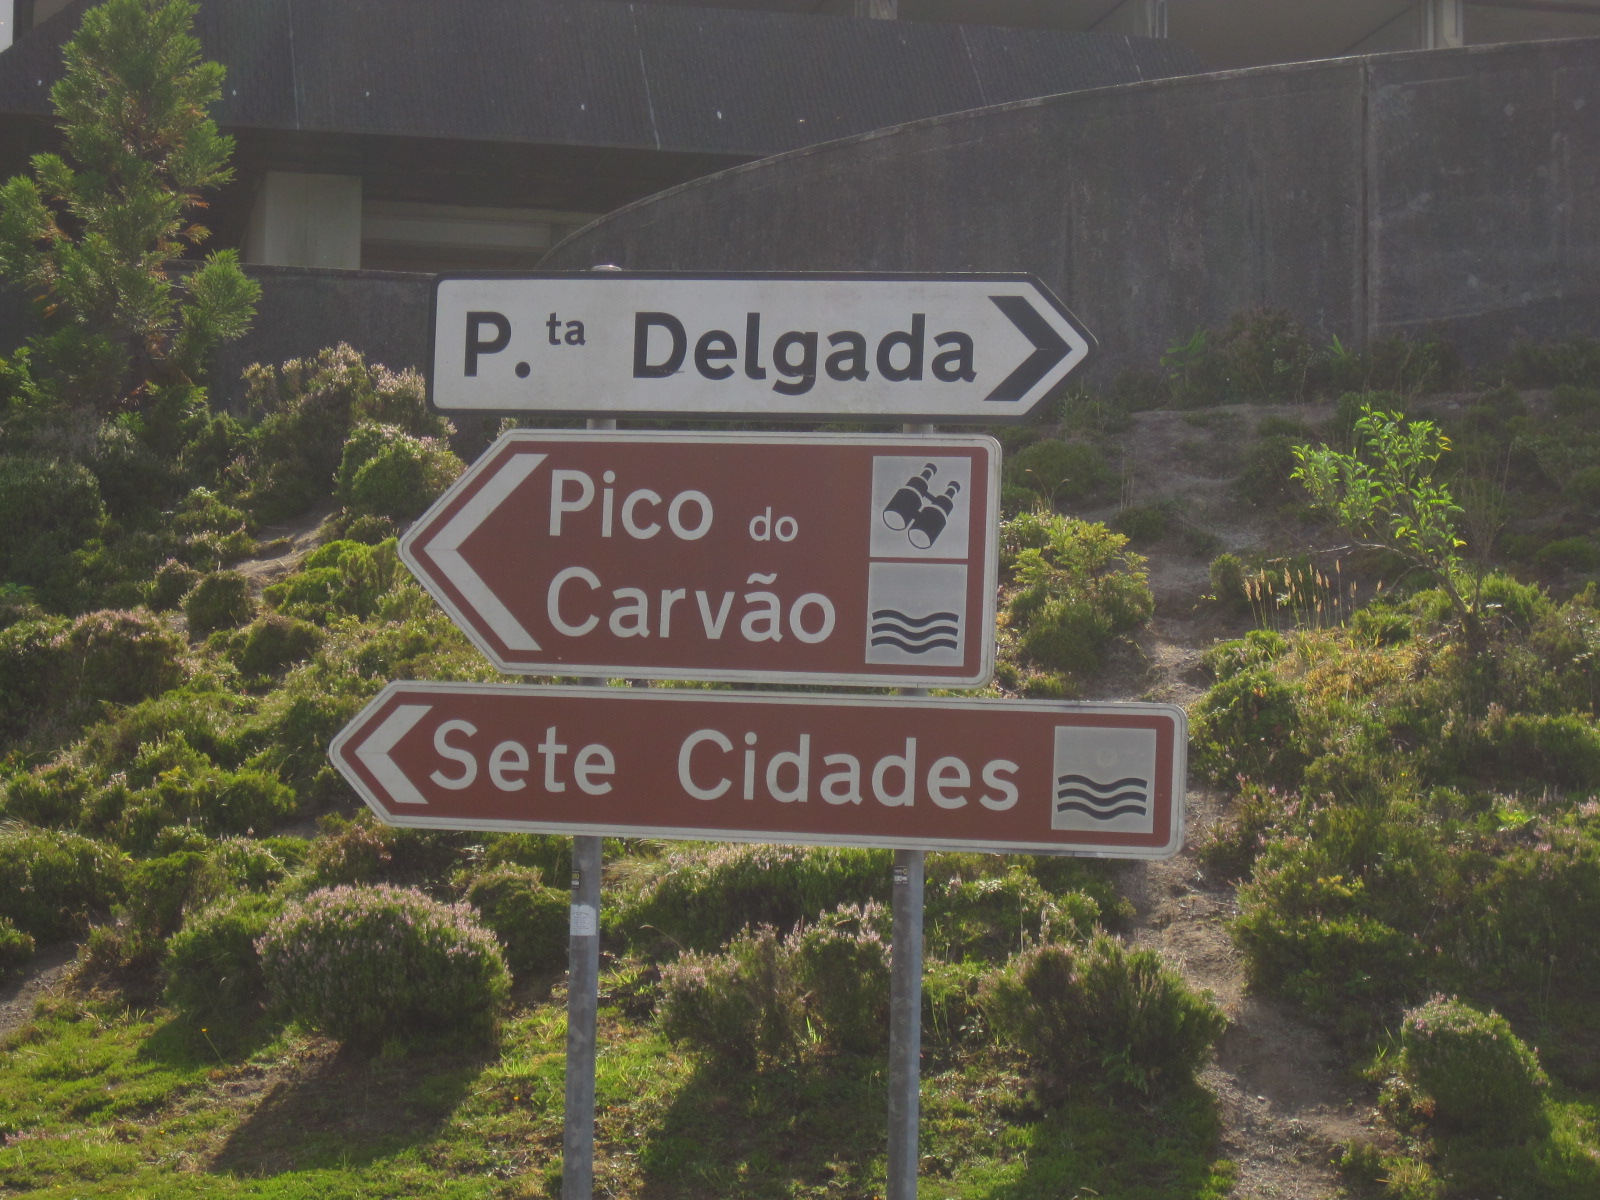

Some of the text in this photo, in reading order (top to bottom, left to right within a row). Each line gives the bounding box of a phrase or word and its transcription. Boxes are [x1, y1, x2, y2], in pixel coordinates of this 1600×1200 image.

[632, 311, 978, 396] Delgada
[549, 469, 799, 543] Pico do
[546, 566, 836, 645] Carvão
[429, 718, 1020, 812] Sete Cidades
